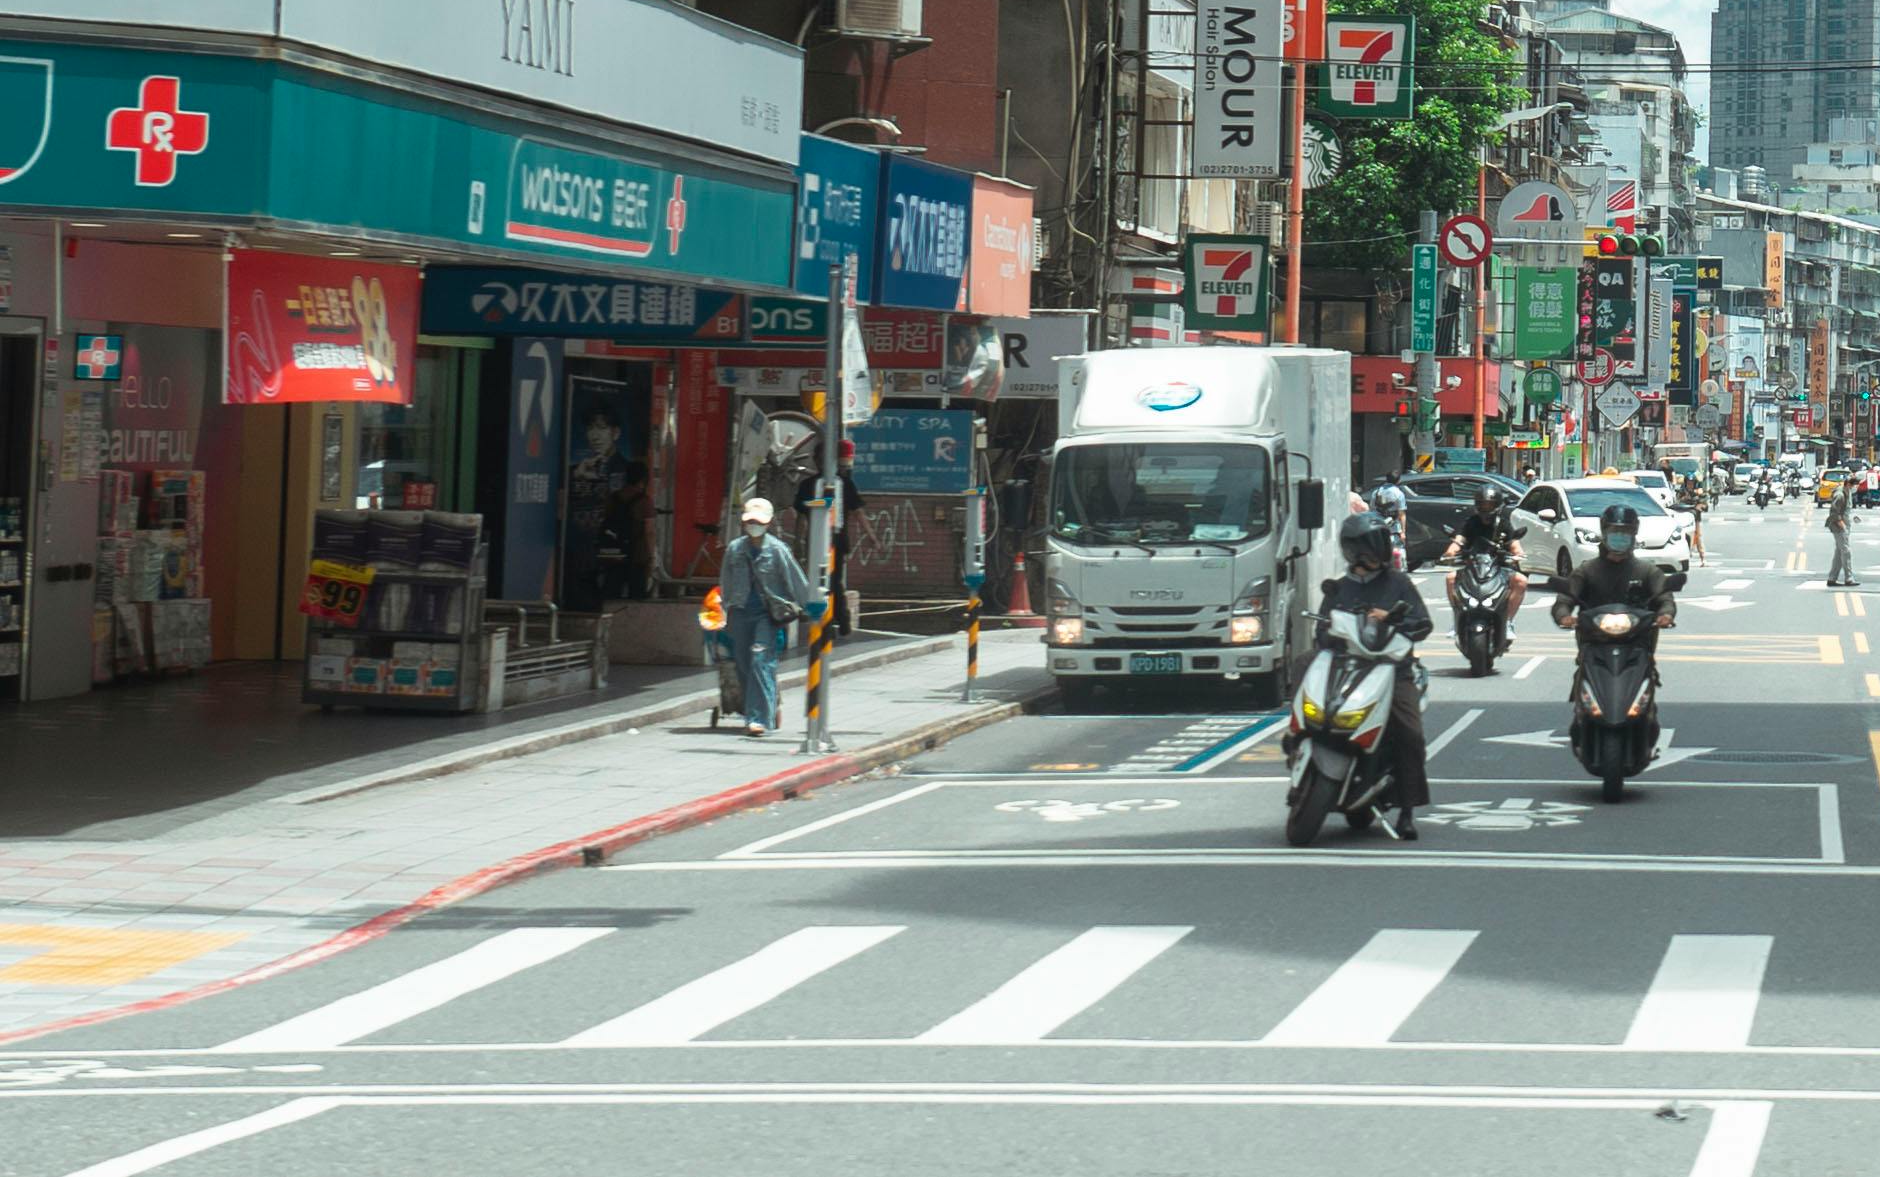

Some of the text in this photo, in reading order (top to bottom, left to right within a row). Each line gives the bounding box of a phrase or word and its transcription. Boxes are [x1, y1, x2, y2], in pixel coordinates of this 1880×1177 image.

[1205, 8, 1220, 92] Hair Salon
[521, 163, 604, 222] watsons
[520, 281, 696, 326] 久大文具連鎖
[1528, 283, 1564, 299] 得意
[716, 316, 739, 334] B1
